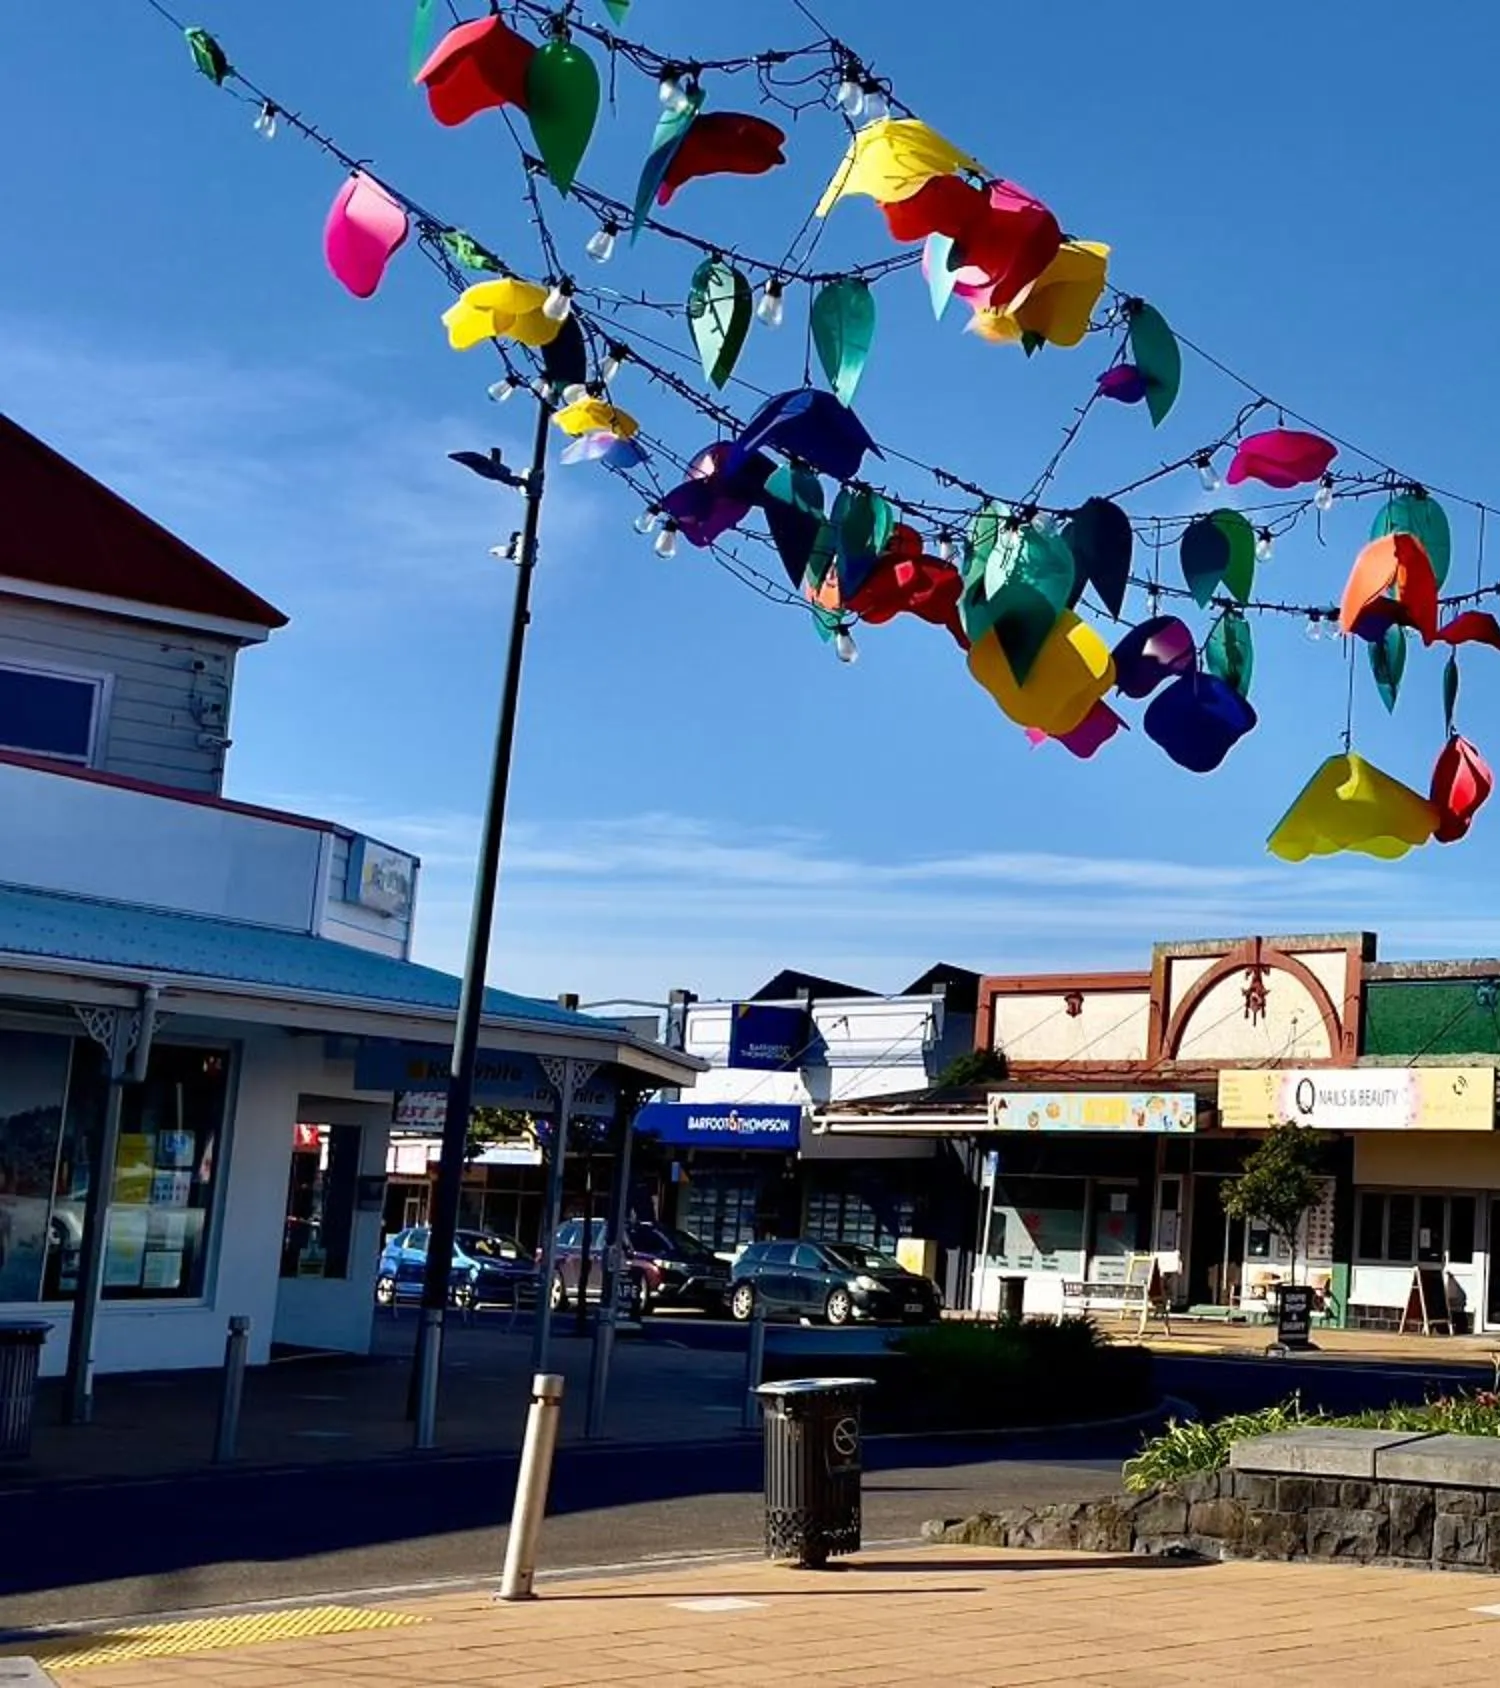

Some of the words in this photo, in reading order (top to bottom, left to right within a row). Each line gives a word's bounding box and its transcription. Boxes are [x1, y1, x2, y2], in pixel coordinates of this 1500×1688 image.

[1295, 1077, 1316, 1115] Q
[1319, 1090, 1347, 1107] NAILS
[1349, 1089, 1357, 1107] &
[1359, 1089, 1399, 1107] BEAUTY
[688, 1115, 730, 1131] BARFOOT
